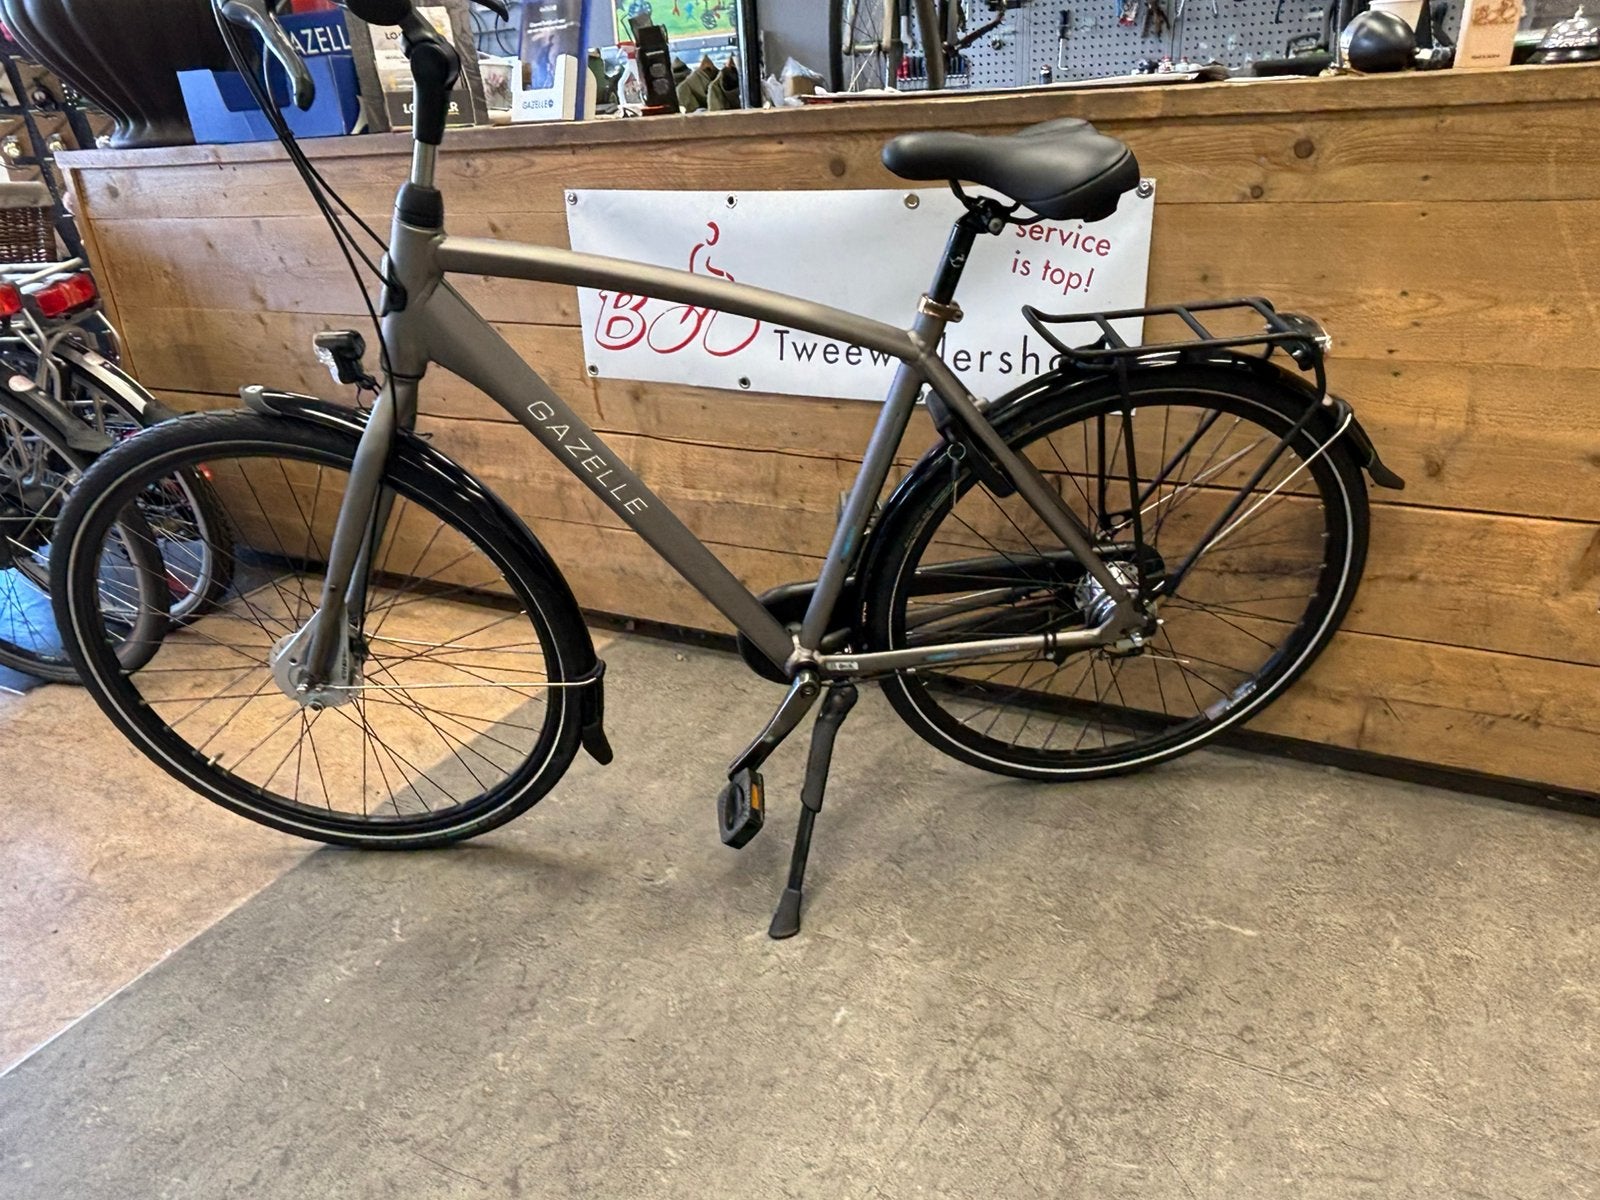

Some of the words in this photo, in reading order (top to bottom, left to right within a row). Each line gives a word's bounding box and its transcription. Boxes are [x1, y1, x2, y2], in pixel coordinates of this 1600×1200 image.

[289, 24, 352, 56] AZELL
[1015, 223, 1111, 257] service
[1012, 249, 1031, 276] is
[1041, 259, 1095, 295] top!
[774, 329, 1062, 376] Tweewlersh
[527, 400, 649, 515] GAZELLE
